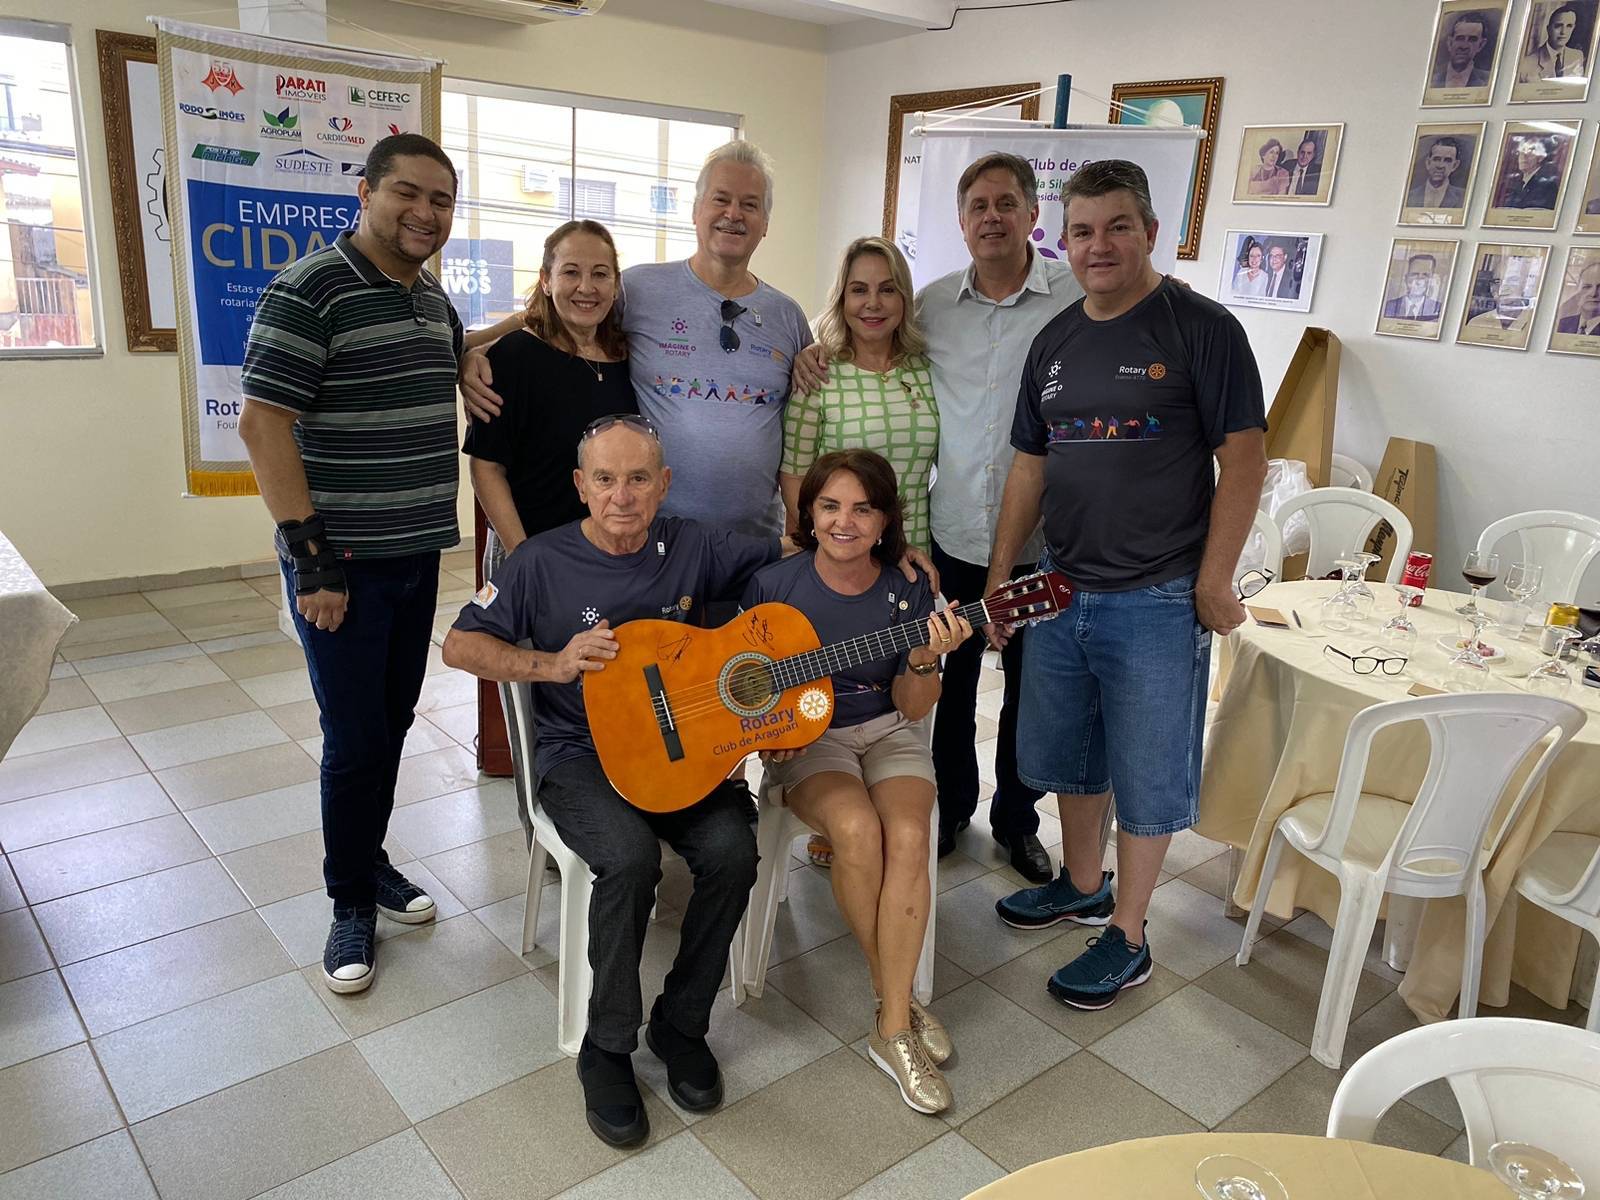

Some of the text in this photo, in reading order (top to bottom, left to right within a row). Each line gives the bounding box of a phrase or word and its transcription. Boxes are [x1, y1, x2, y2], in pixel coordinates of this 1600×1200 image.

[275, 74, 327, 96] PARATI
[367, 89, 411, 104] CEFERC
[316, 133, 366, 145] CARDIOMED
[275, 158, 333, 173] SUDESTE
[1060, 158, 1077, 171] de
[238, 199, 362, 230] EMPRESA
[227, 282, 254, 294] Estas
[1118, 365, 1147, 376] Rotary
[740, 707, 795, 733] Rotary
[712, 722, 799, 756] Club de Araguari
